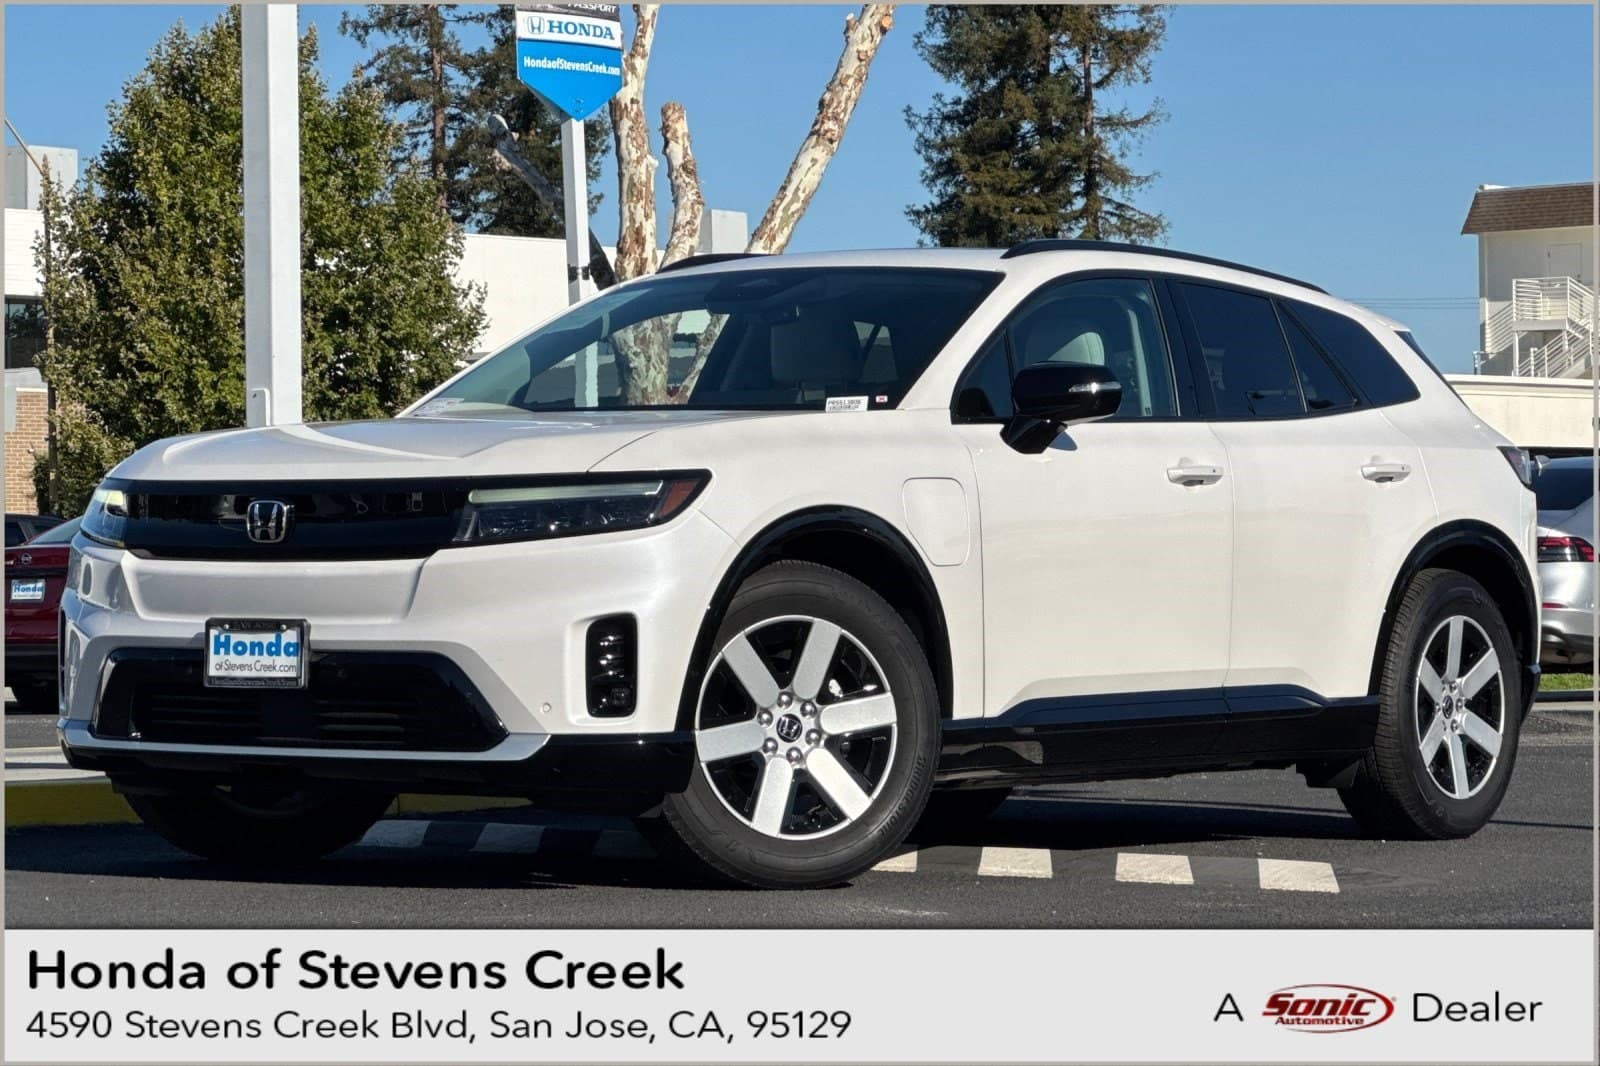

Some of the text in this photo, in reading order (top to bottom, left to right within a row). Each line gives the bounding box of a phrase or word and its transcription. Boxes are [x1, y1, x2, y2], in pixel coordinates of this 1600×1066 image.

[547, 20, 615, 40] HONDA
[523, 55, 621, 76] HondaofStevensCreek.com
[14, 583, 44, 593] Honda
[213, 632, 299, 657] Honda
[214, 658, 297, 672] of Stevens Creek.com
